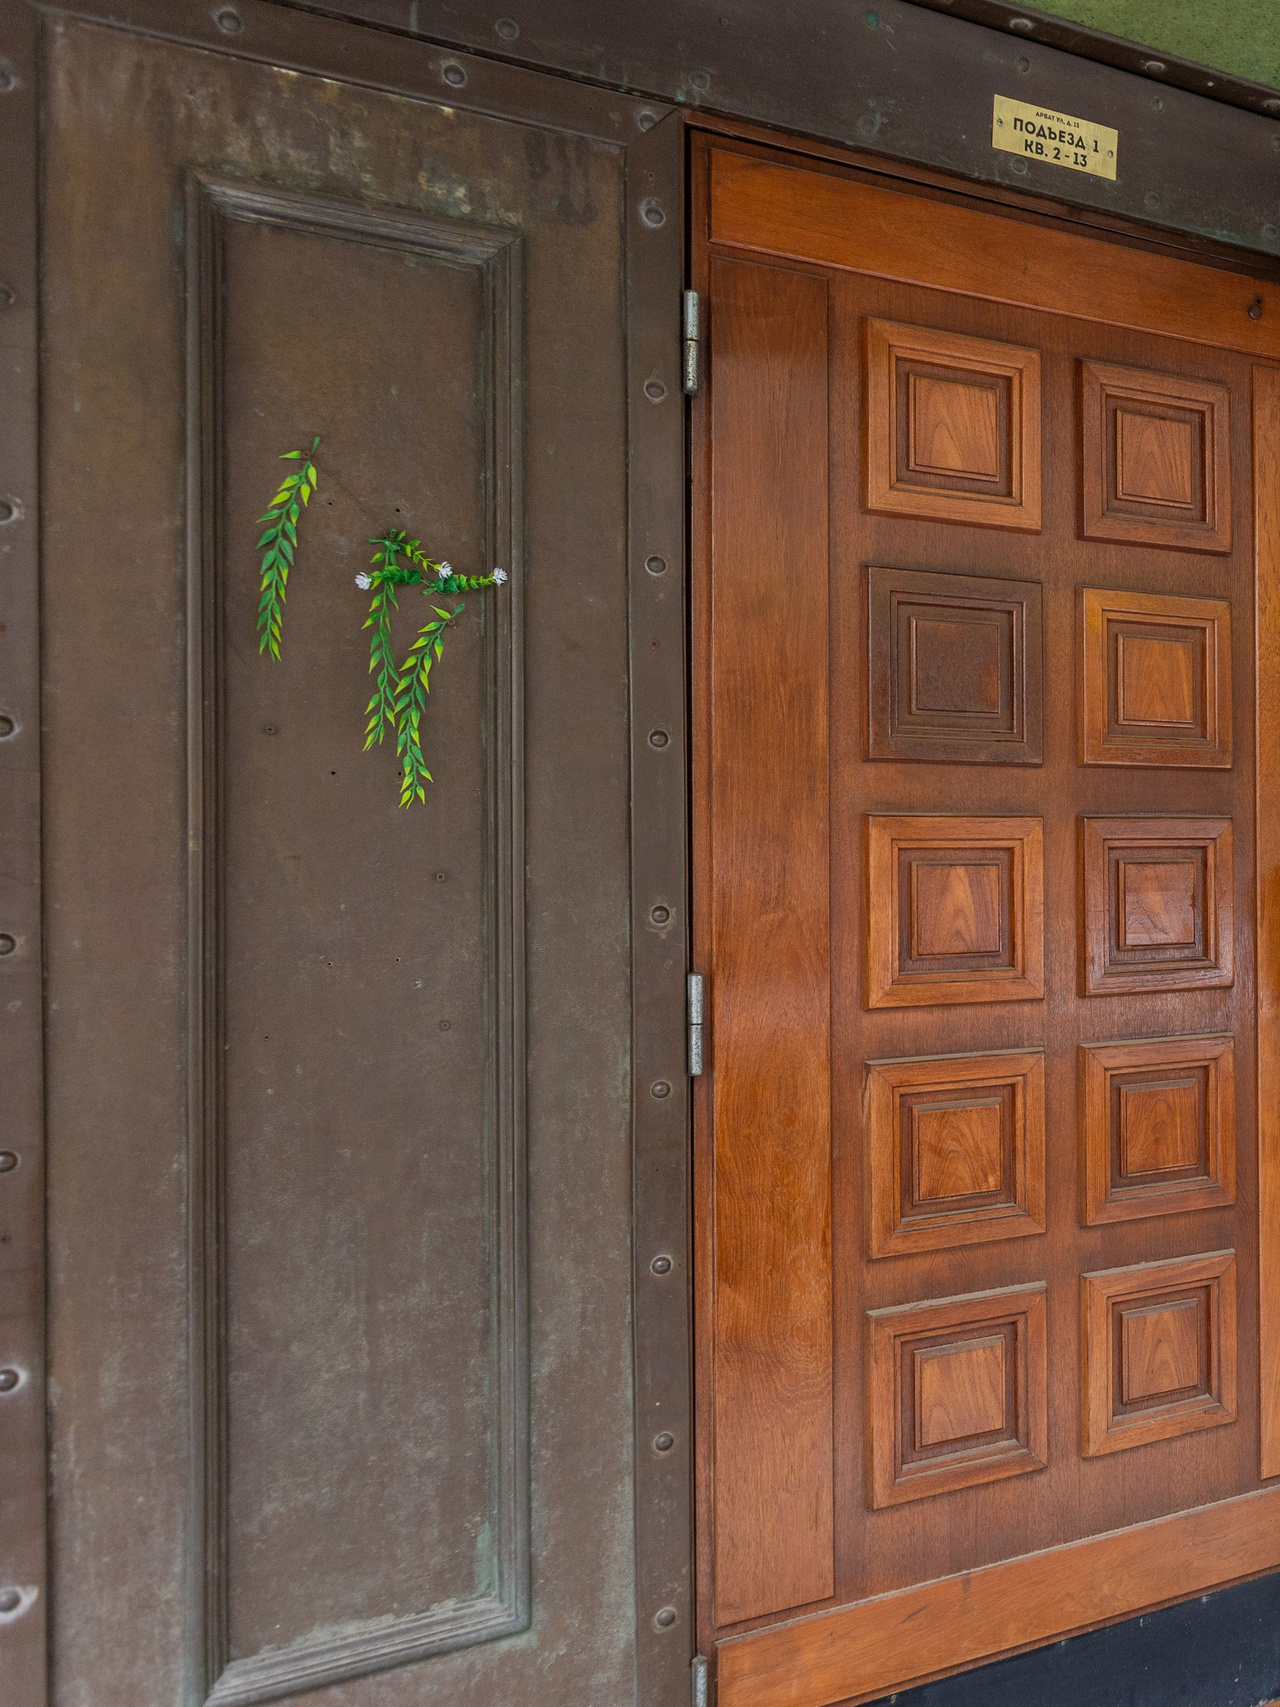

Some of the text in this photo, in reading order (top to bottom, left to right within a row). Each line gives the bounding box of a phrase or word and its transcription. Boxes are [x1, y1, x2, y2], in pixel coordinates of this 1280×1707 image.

[1035, 111, 1055, 121] АРБАТ
[1056, 116, 1066, 125] УЛ.
[1013, 117, 1099, 153] ПОДЪЕЗД 1
[1024, 139, 1048, 157] КВ.
[1053, 147, 1061, 160] 2
[1073, 152, 1088, 167] 13
